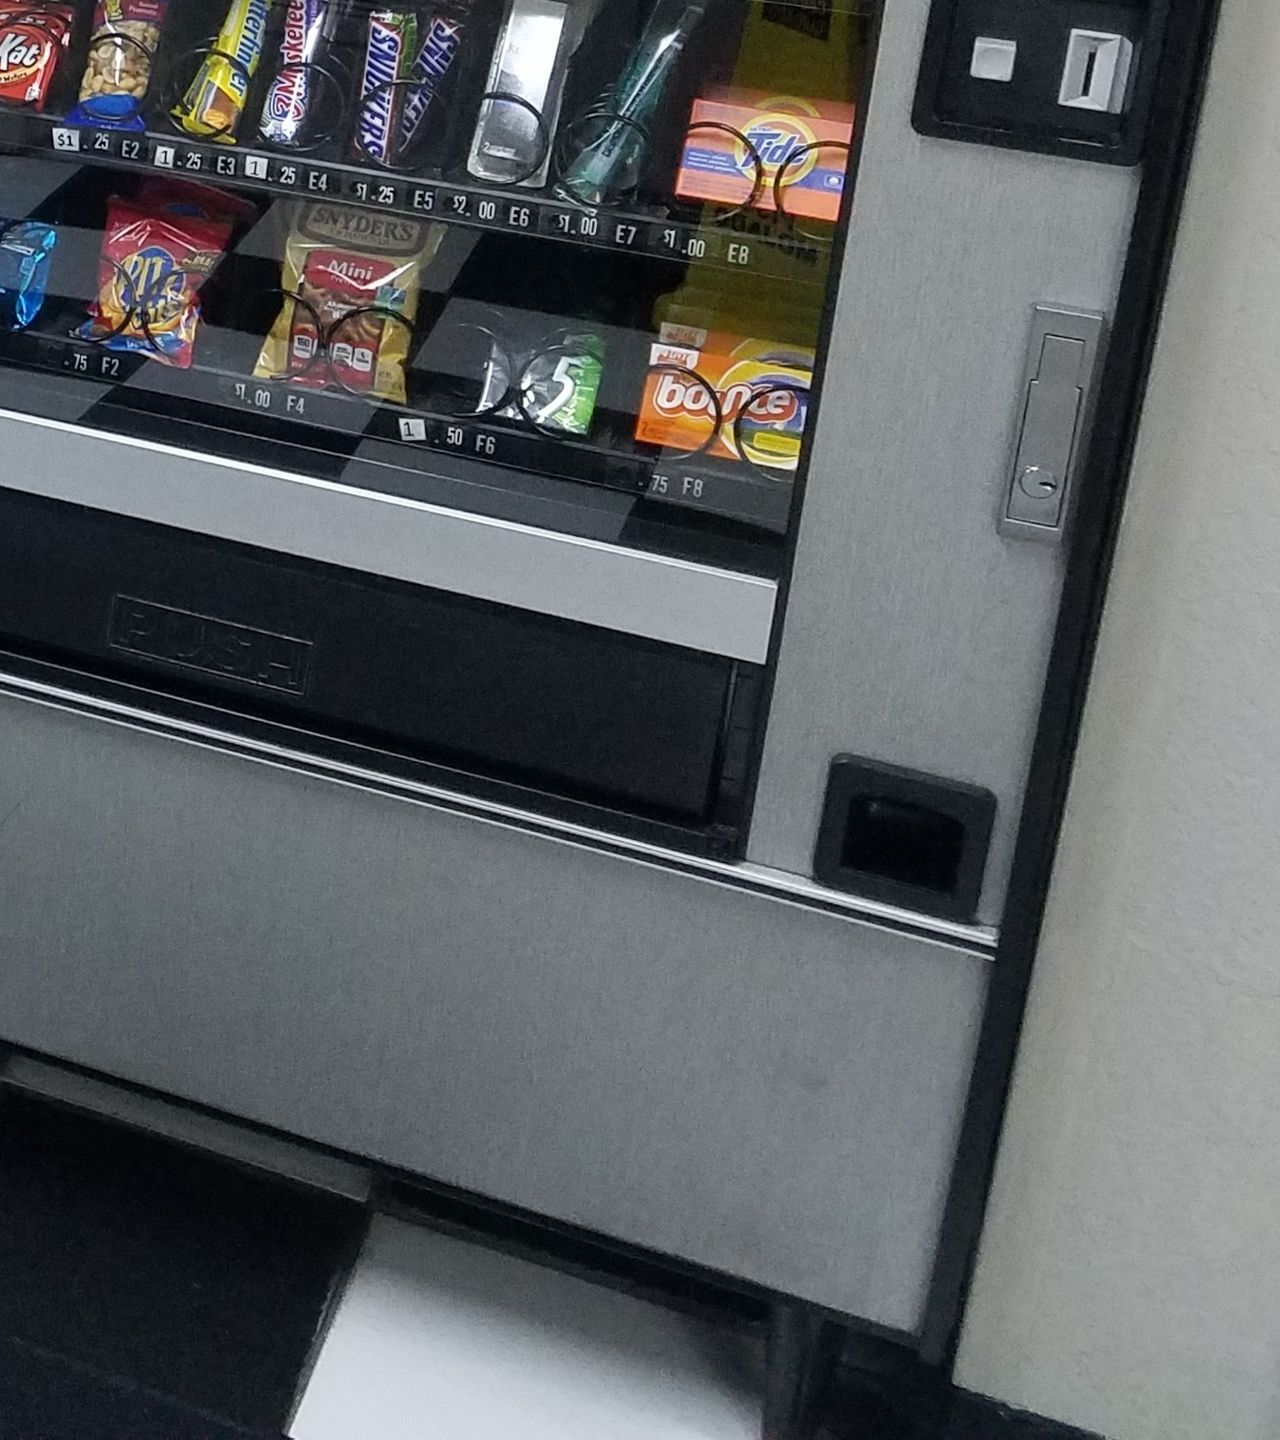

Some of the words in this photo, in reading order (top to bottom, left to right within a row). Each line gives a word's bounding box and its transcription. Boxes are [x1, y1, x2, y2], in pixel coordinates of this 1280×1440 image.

[121, 140, 139, 158] E2
[737, 131, 811, 169] Tide
[216, 156, 235, 176] E3
[308, 170, 328, 192] E4
[413, 189, 434, 210] E5
[508, 205, 530, 227] E6
[615, 225, 637, 245] E7
[727, 243, 750, 265] E8
[329, 259, 374, 281] Mini
[101, 357, 120, 376] F2
[539, 356, 583, 424] 5
[286, 393, 306, 414] F4
[475, 433, 497, 456] F6
[682, 477, 704, 499] F8
